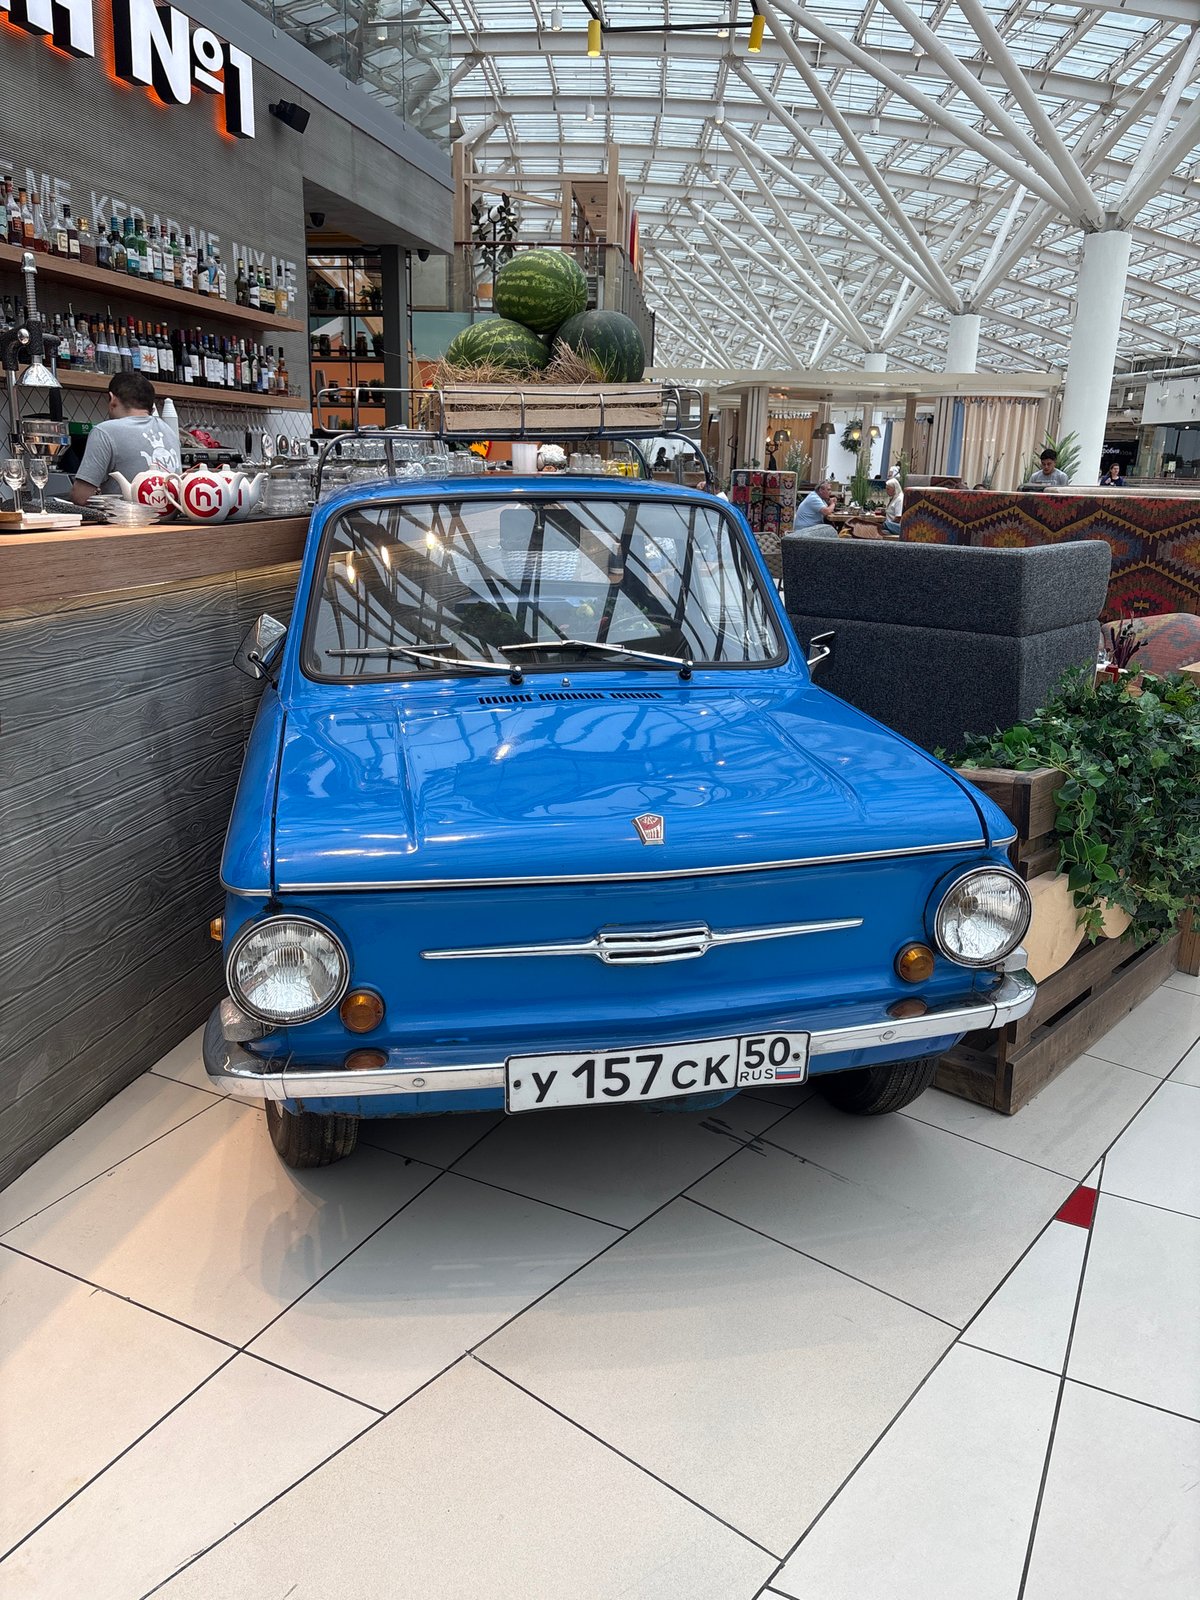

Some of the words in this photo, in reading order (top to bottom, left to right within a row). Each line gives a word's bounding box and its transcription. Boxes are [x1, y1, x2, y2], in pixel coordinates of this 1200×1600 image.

[744, 1036, 791, 1069] 50
[572, 1054, 664, 1099] 157
[672, 1054, 731, 1090] СК
[739, 1069, 774, 1083] RUS
